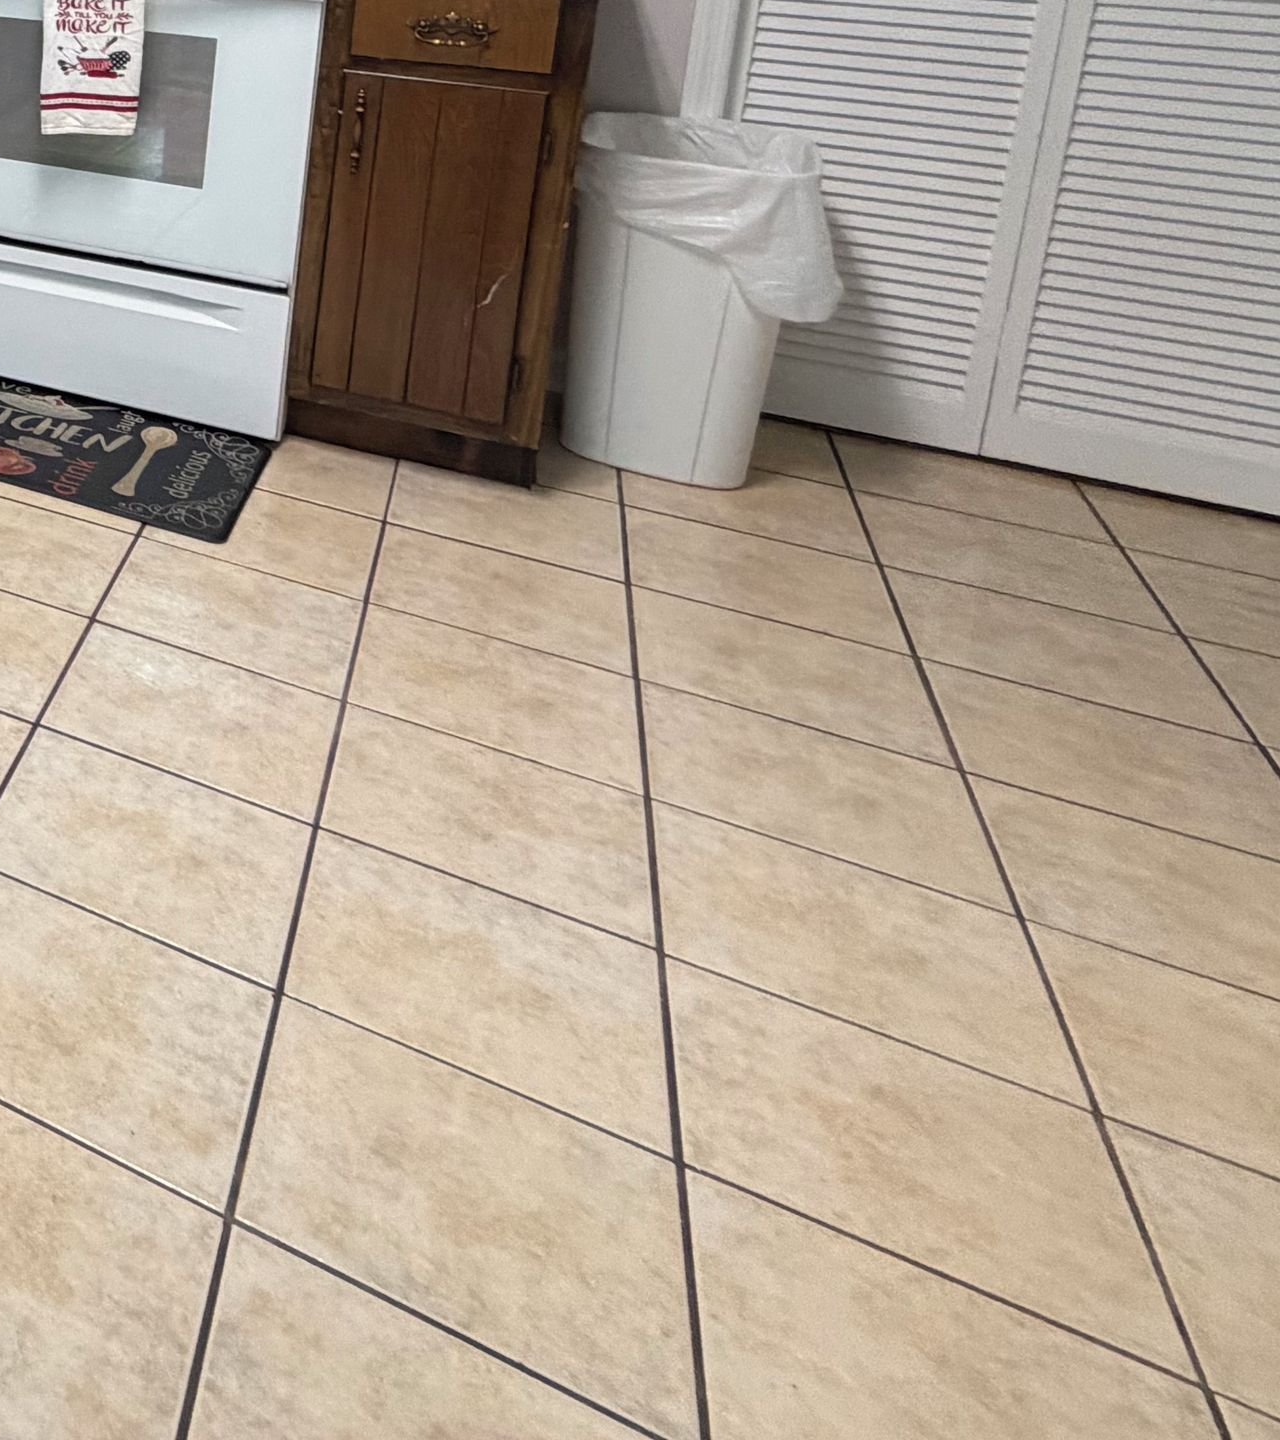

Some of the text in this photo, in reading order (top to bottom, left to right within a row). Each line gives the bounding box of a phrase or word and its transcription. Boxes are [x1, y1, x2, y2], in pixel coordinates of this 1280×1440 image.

[113, 21, 132, 34] IT
[48, 457, 97, 497] drink
[162, 450, 212, 499] delicious
